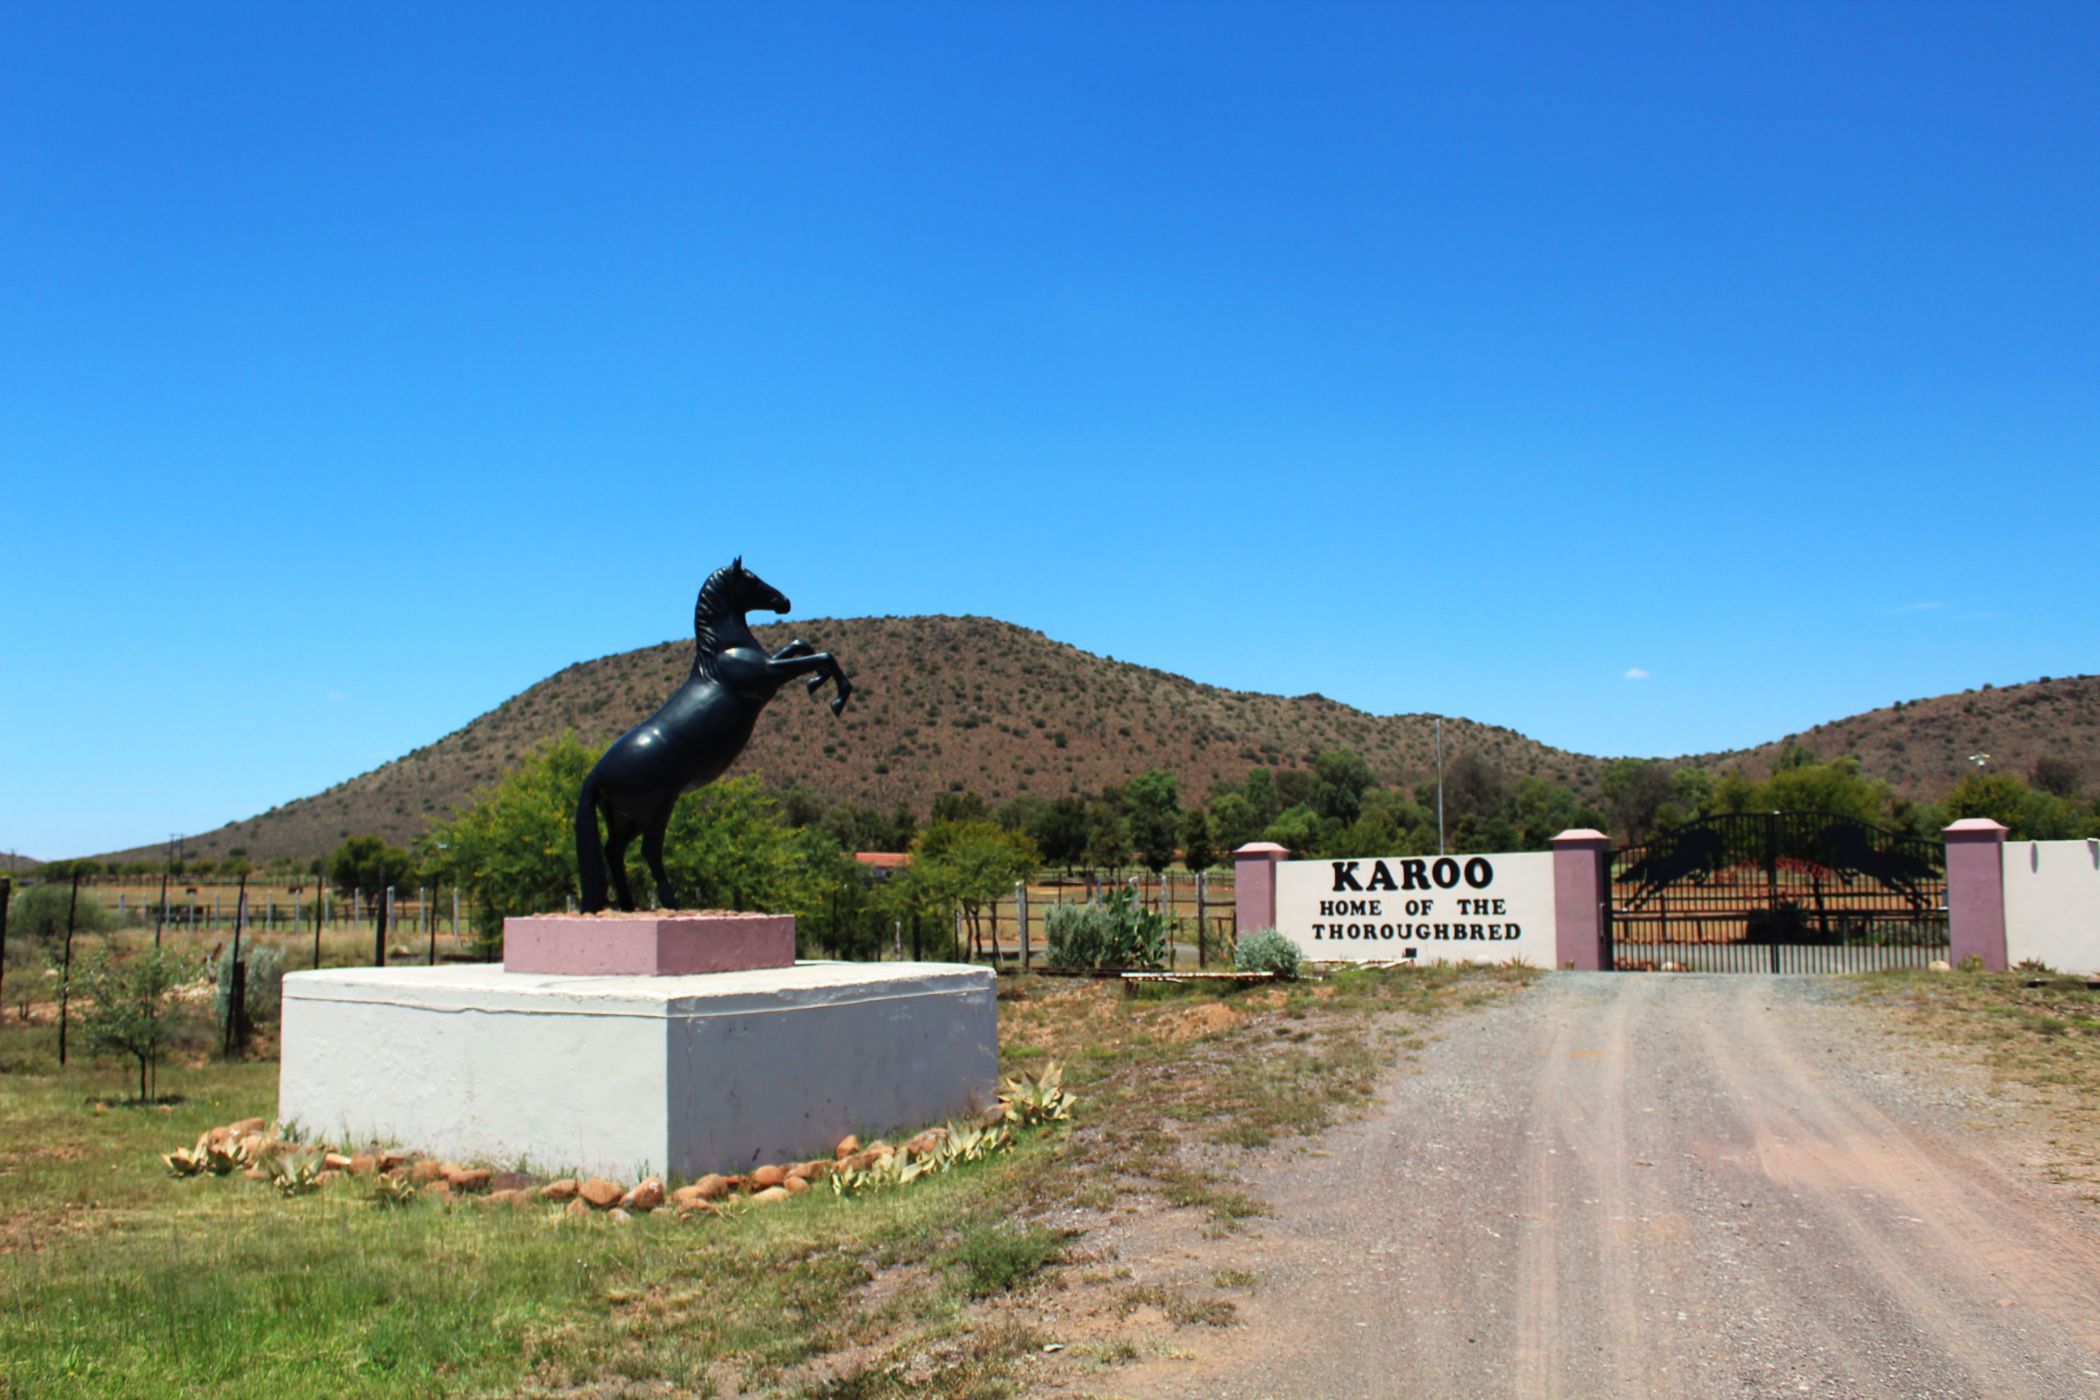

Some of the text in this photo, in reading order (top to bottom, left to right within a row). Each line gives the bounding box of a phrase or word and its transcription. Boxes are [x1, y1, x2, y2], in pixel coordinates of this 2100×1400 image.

[1331, 857, 1494, 892] KAROO
[1319, 898, 1506, 916] HOME OF THE
[1312, 923, 1521, 941] THOROUGHBRED
